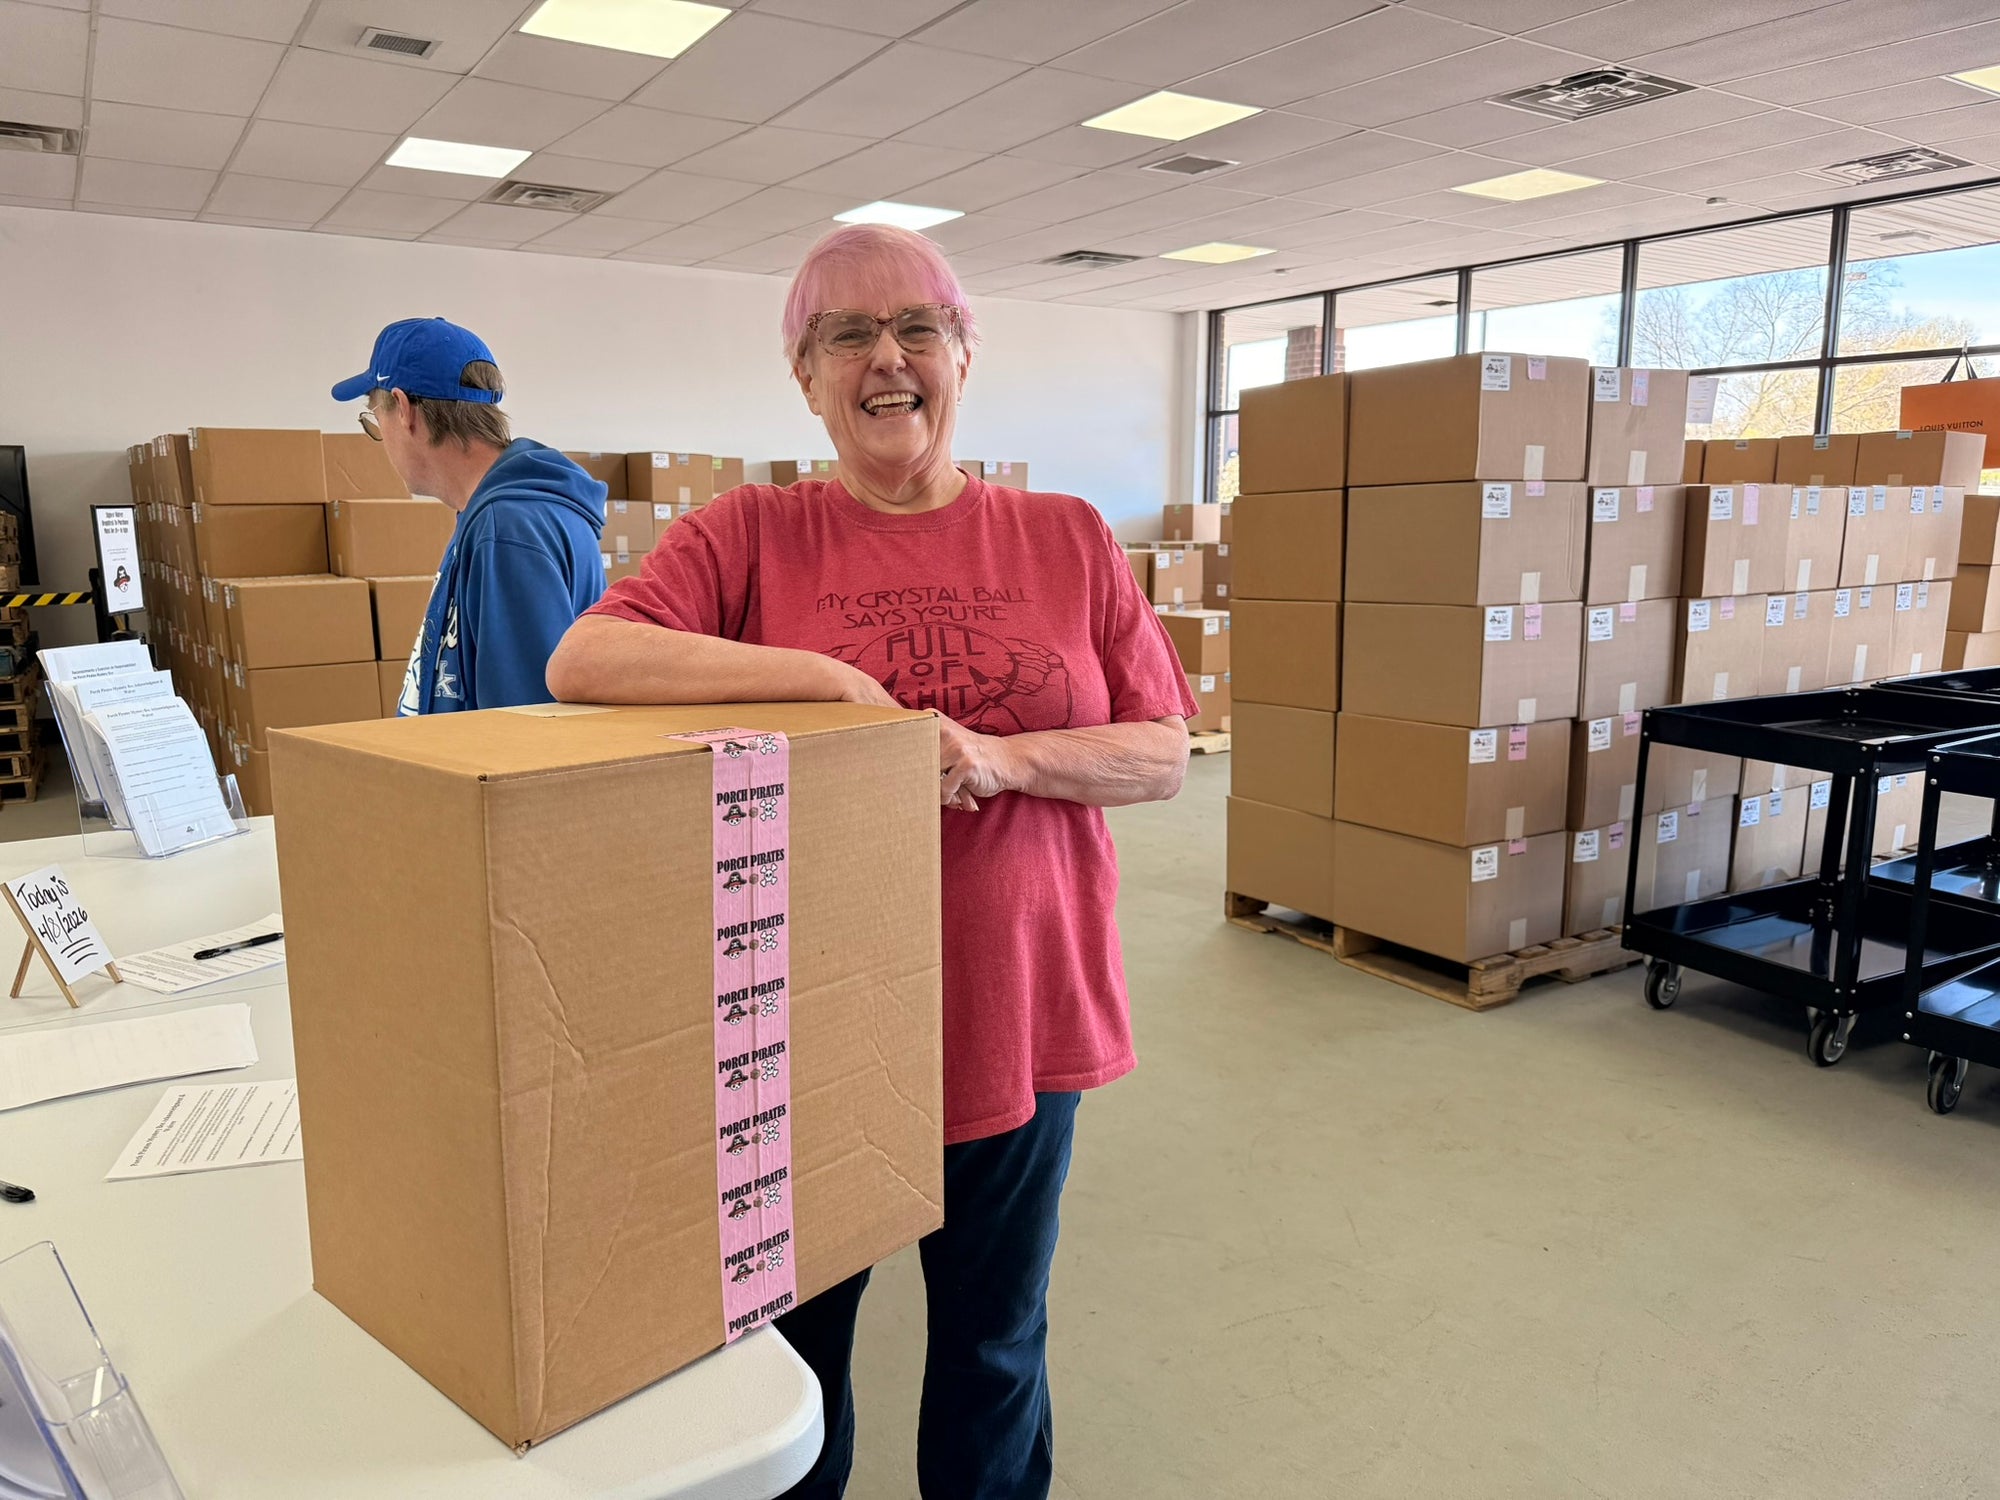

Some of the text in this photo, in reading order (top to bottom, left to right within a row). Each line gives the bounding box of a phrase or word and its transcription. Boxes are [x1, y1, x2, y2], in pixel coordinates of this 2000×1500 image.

[1920, 420, 1984, 432] LOUIS VUITTON
[816, 587, 1033, 613] MY CRYSTAL BALL
[843, 605, 1008, 629] SAYS YOU'RE
[887, 627, 985, 662] FULL
[910, 660, 963, 684] OF
[717, 783, 784, 806] PORCH PIRATES
[717, 849, 785, 874] PORCH PIRATES
[16, 882, 63, 911] Today
[38, 907, 88, 945] 4/8/2026
[717, 913, 785, 941] PORCH PIRATES
[718, 977, 785, 1008] PORCH PIRATES
[718, 1041, 786, 1073] PORCH PIRATES
[720, 1104, 786, 1139] PORCH PIRATES
[722, 1167, 788, 1204] PORCH PIRATES
[725, 1229, 790, 1269] PORCH PIRATES
[729, 1291, 793, 1334] PORCH PIRATES
